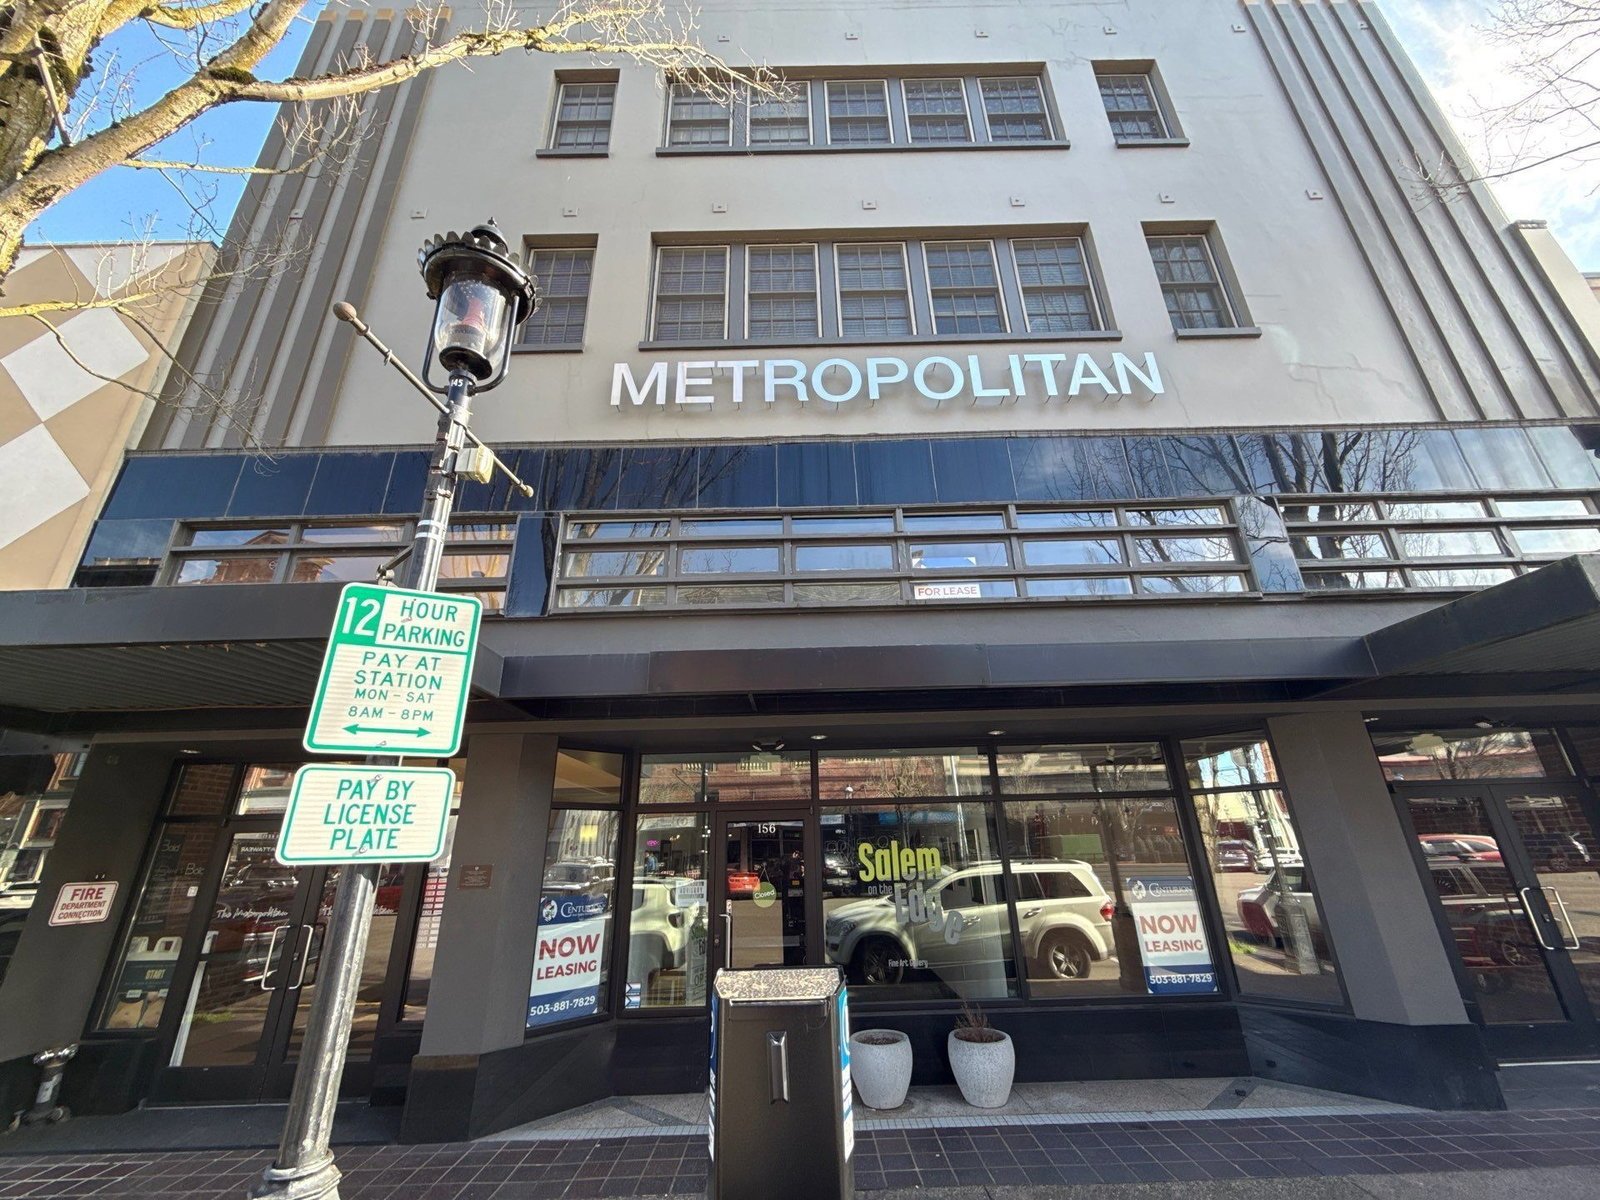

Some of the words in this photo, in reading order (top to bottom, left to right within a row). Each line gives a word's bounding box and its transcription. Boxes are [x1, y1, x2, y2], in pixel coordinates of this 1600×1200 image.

[610, 351, 1165, 405] METROPOLITAN
[918, 587, 941, 597] FOR
[943, 586, 978, 596] LEASE
[342, 596, 382, 638] 12
[400, 599, 458, 623] HOUR
[381, 623, 466, 648] PARKING
[362, 651, 408, 669] PAY
[415, 656, 442, 672] AT
[354, 669, 442, 691] STATION
[354, 687, 388, 701] MON
[406, 691, 434, 704] SAT
[348, 705, 383, 719] 8AM
[400, 709, 434, 722] 8PM
[336, 779, 379, 801] PAY
[385, 780, 415, 801] BY
[323, 803, 417, 825] LICENSE
[330, 828, 401, 850] PLATE
[757, 823, 776, 834] 156
[858, 840, 942, 883] Salem
[70, 887, 106, 901] FIRE
[754, 888, 776, 900] Closed
[867, 885, 878, 895] on
[878, 883, 893, 895] the
[58, 910, 103, 920] CONNECTION
[60, 900, 107, 911] DEPARTMENT
[216, 907, 231, 919] The
[893, 881, 964, 945] Edge
[1139, 914, 1197, 935] NOW
[538, 933, 601, 960] NOW
[1144, 939, 1204, 953] LEASING
[536, 960, 597, 981] LEASING
[888, 958, 899, 967] Fine
[145, 969, 166, 980] START
[1149, 973, 1213, 984] 503-881-7829
[529, 996, 596, 1017] 503-881-7829
